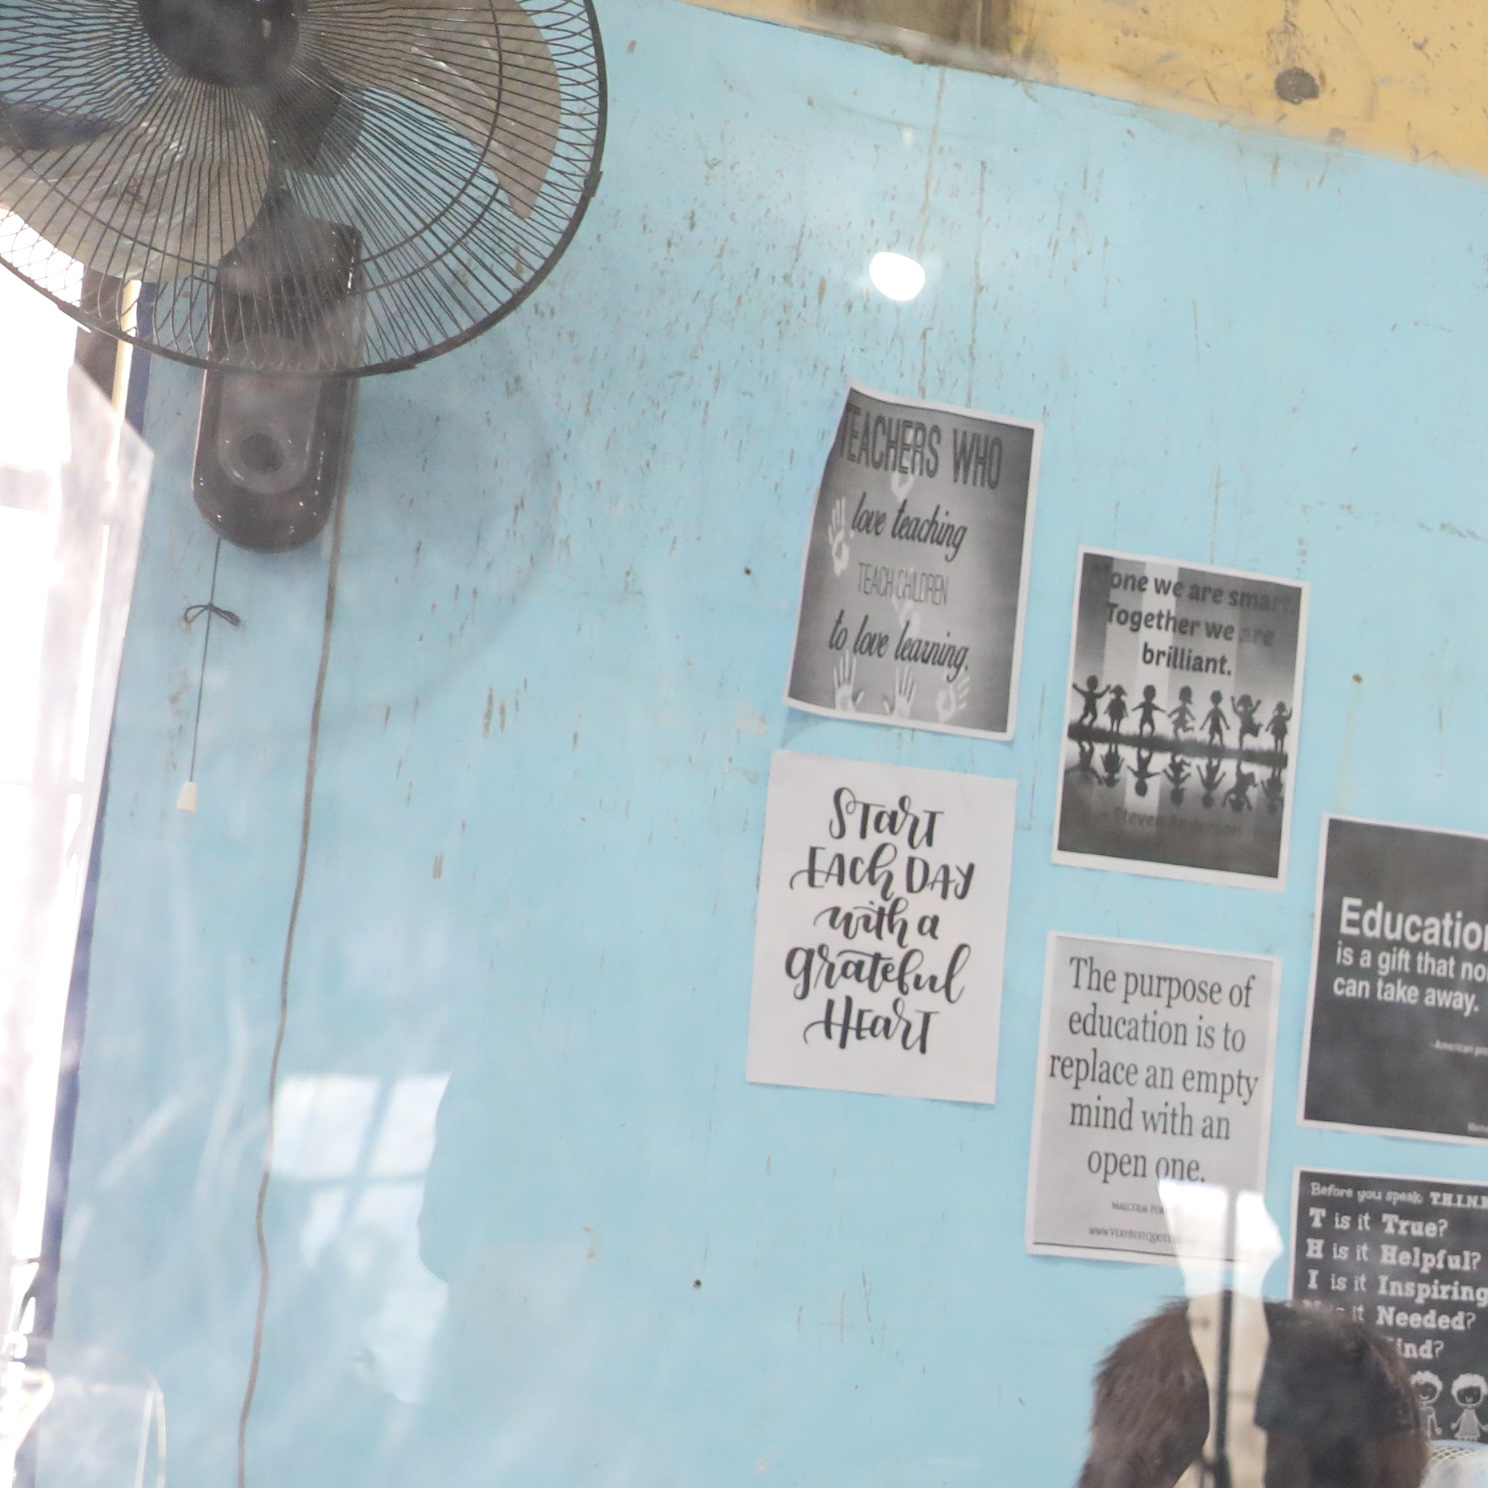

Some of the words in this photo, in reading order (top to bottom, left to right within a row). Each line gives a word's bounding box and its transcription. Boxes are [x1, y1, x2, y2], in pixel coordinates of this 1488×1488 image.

[838, 404, 942, 480] TEACHERS
[951, 427, 1003, 490] WHO
[851, 491, 886, 537] love
[890, 499, 968, 562] teaching
[857, 562, 894, 596] TEACH
[896, 568, 948, 606] CHILDREN
[1153, 575, 1184, 598] we
[1188, 583, 1224, 605] are
[829, 609, 848, 651] to
[853, 614, 890, 658] love
[894, 620, 970, 682] learning.
[1106, 602, 1201, 637] Together
[1204, 620, 1235, 642] we
[1238, 626, 1276, 648] are
[1142, 641, 1232, 677] brilliant.
[906, 856, 975, 900] DAY
[813, 896, 909, 949] with
[917, 914, 940, 940] a
[784, 943, 972, 1004] grateful
[1335, 940, 1354, 966] is
[1359, 948, 1372, 968] a
[1377, 946, 1411, 976] gift
[1416, 951, 1456, 978] that
[1069, 956, 1117, 994] The
[1123, 971, 1222, 1009] purpose
[1229, 974, 1257, 1008] of
[1332, 976, 1371, 999] can
[1376, 979, 1420, 1005] take
[1423, 987, 1480, 1017] away.
[1068, 1002, 1188, 1047] education
[1196, 1015, 1216, 1050] is
[1223, 1021, 1247, 1053] to
[1049, 1048, 1139, 1091] replace
[1145, 1064, 1175, 1091] an
[1181, 1067, 1260, 1107] empty
[1069, 1095, 1135, 1132] mind
[1141, 1101, 1195, 1138] with
[1201, 1113, 1231, 1141] an
[1087, 1149, 1148, 1184] open
[1154, 1156, 1206, 1184] one.
[1310, 1182, 1353, 1199] Before
[1356, 1188, 1382, 1203] you
[1309, 1207, 1326, 1229] T
[1334, 1213, 1351, 1230] is
[1357, 1212, 1371, 1231] it
[1381, 1213, 1449, 1238] True?
[1306, 1238, 1324, 1260] H
[1332, 1243, 1349, 1261] is
[1355, 1243, 1369, 1262] it
[1380, 1244, 1482, 1274] Helpful?
[1308, 1269, 1319, 1290] I
[1331, 1273, 1347, 1291] is
[1353, 1273, 1367, 1292] it
[1352, 1304, 1365, 1322] it
[1376, 1305, 1477, 1331] Needed?
[1396, 1338, 1445, 1360] ind?
